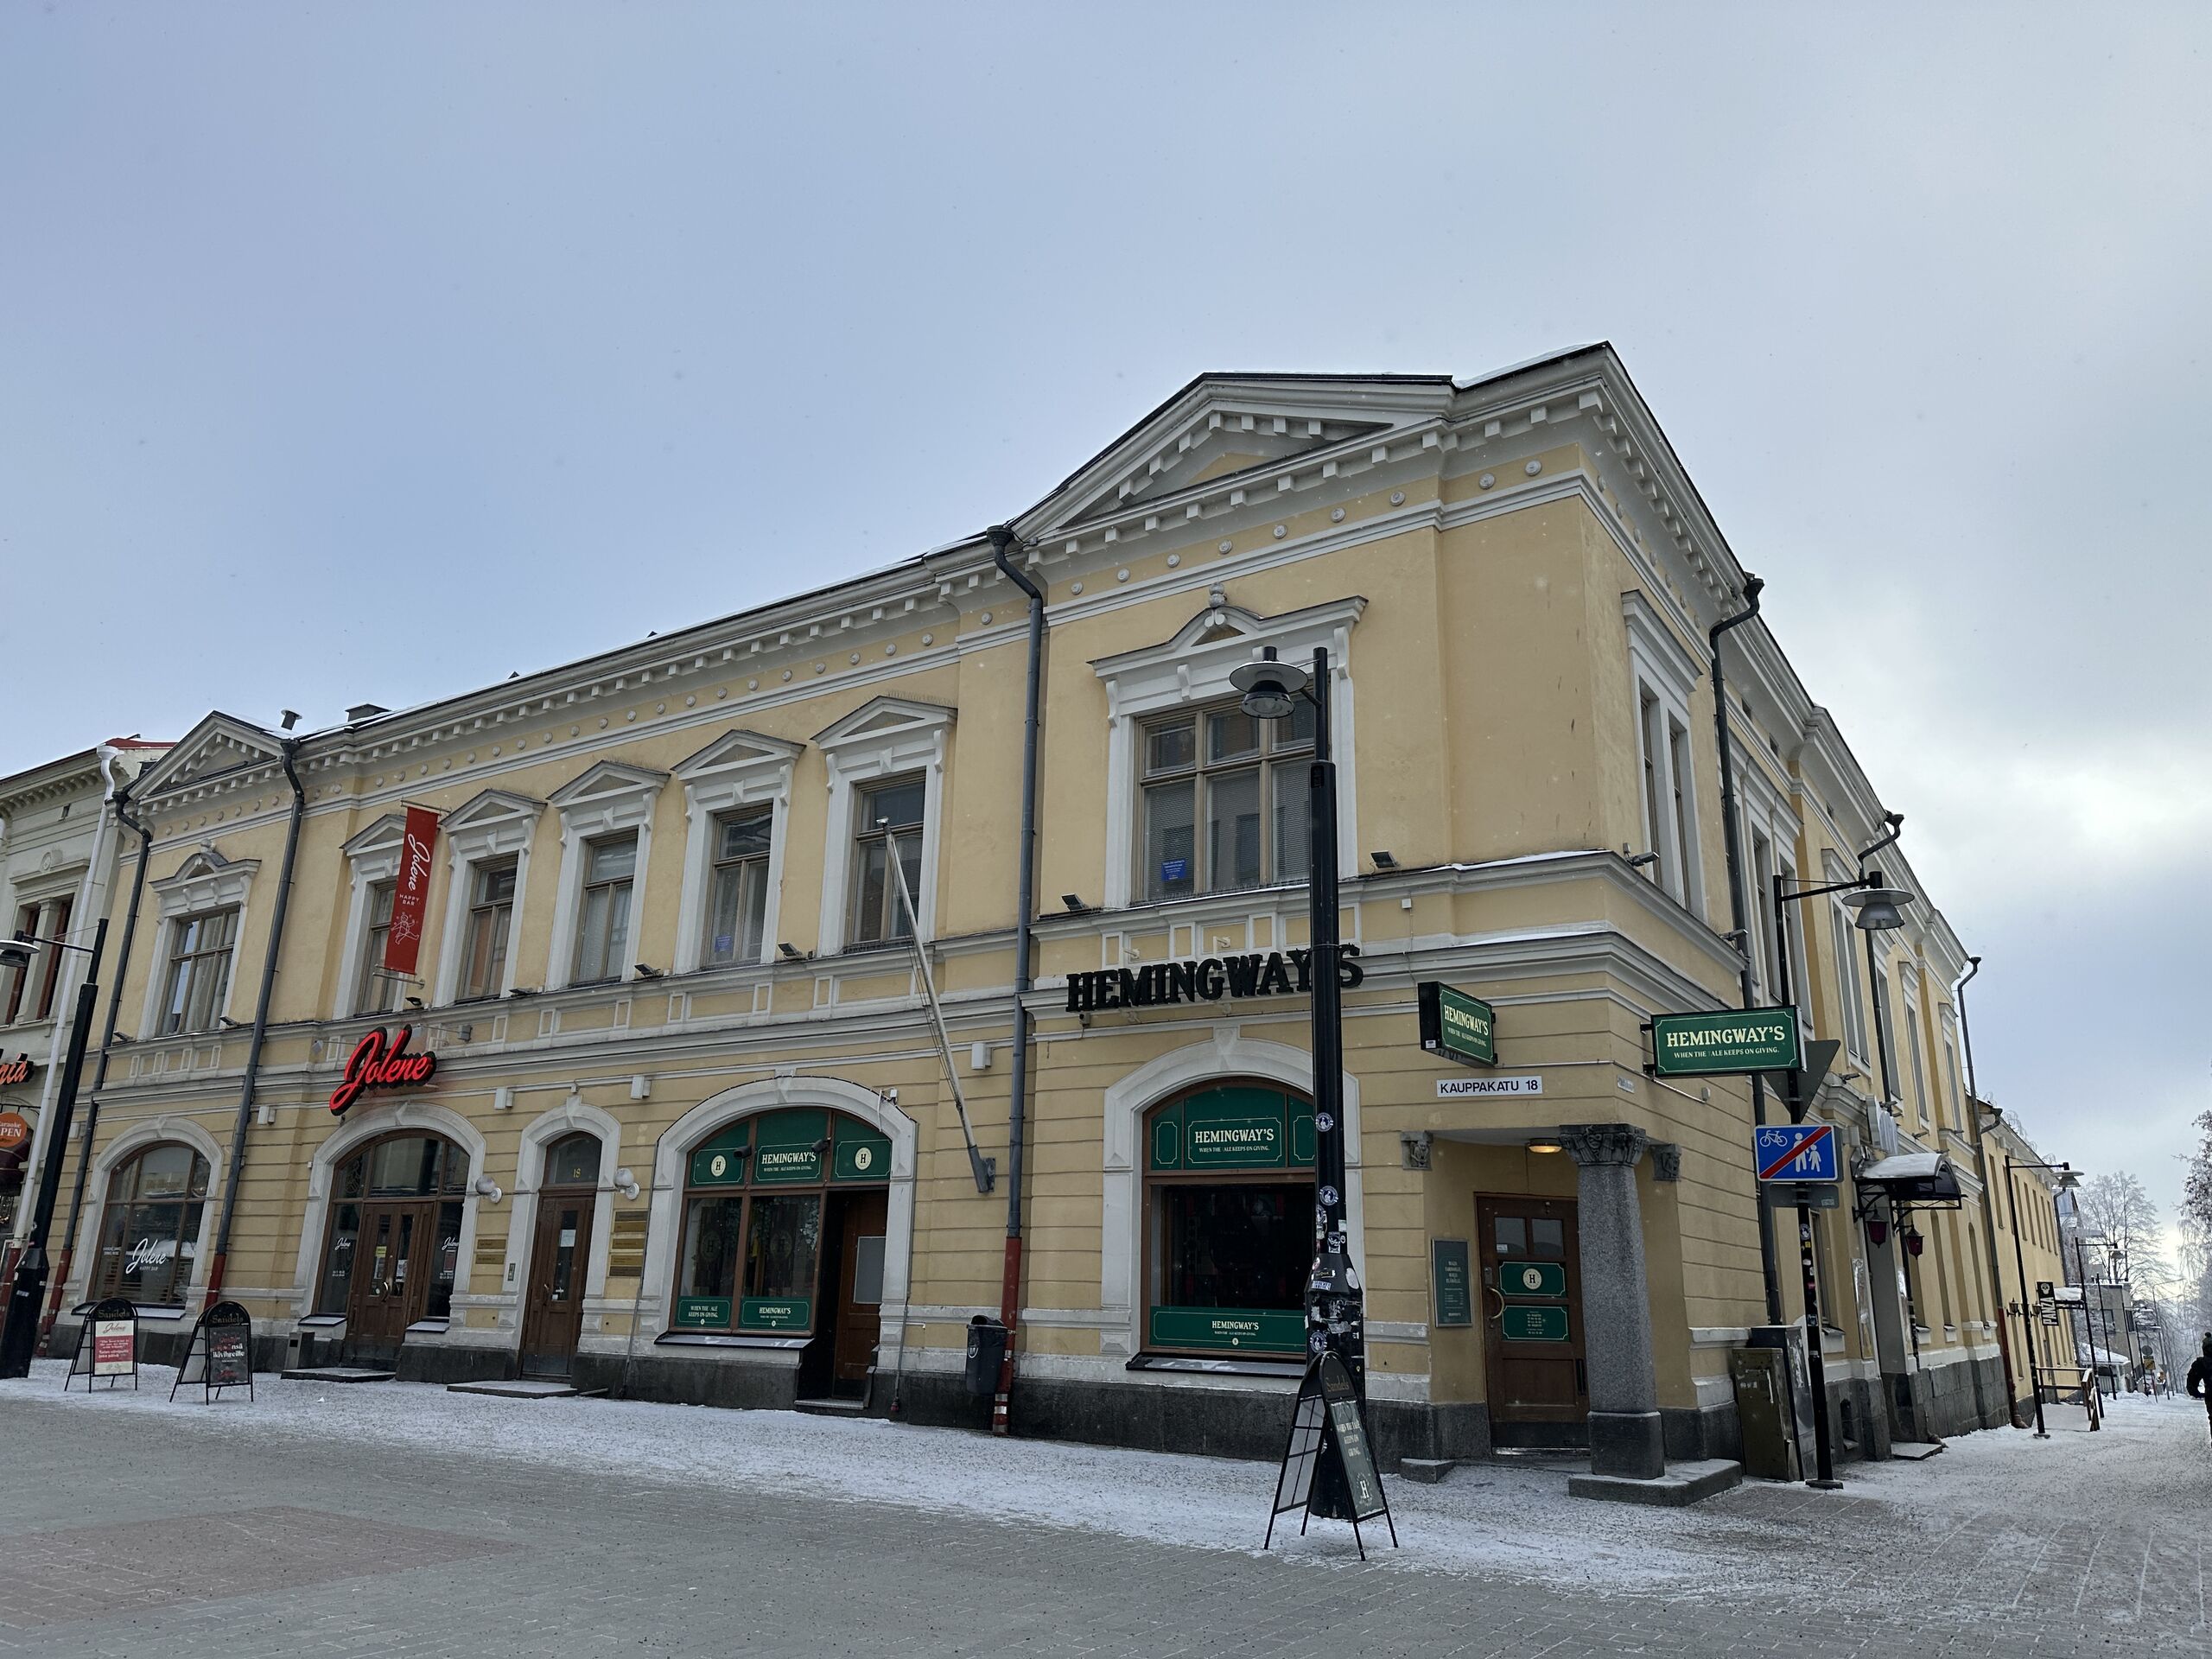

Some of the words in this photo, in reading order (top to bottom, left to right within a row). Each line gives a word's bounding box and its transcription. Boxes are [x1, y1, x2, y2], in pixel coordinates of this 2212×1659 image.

[408, 834, 430, 891] Jolene
[1065, 944, 1364, 1013] HEMINGWAYS
[1444, 1005, 1489, 1036] HEMINGWAY'S
[1666, 1026, 1785, 1047] HEMINGWAY'S
[329, 1027, 435, 1114] Jolene
[1440, 1080, 1519, 1094] KAUPPAKATU
[1525, 1079, 1539, 1090] 18
[1194, 1128, 1274, 1143] HEMINGWAY'S
[761, 1152, 817, 1165] HEMINGWAY'S
[573, 1168, 582, 1179] 18
[125, 1237, 167, 1274] Jolene
[2040, 1296, 2057, 1325] PANZA
[1211, 1320, 1259, 1331] HEMINGWAY'S
[1325, 1375, 1350, 1392] Sandels
[1359, 1480, 1370, 1498] H
